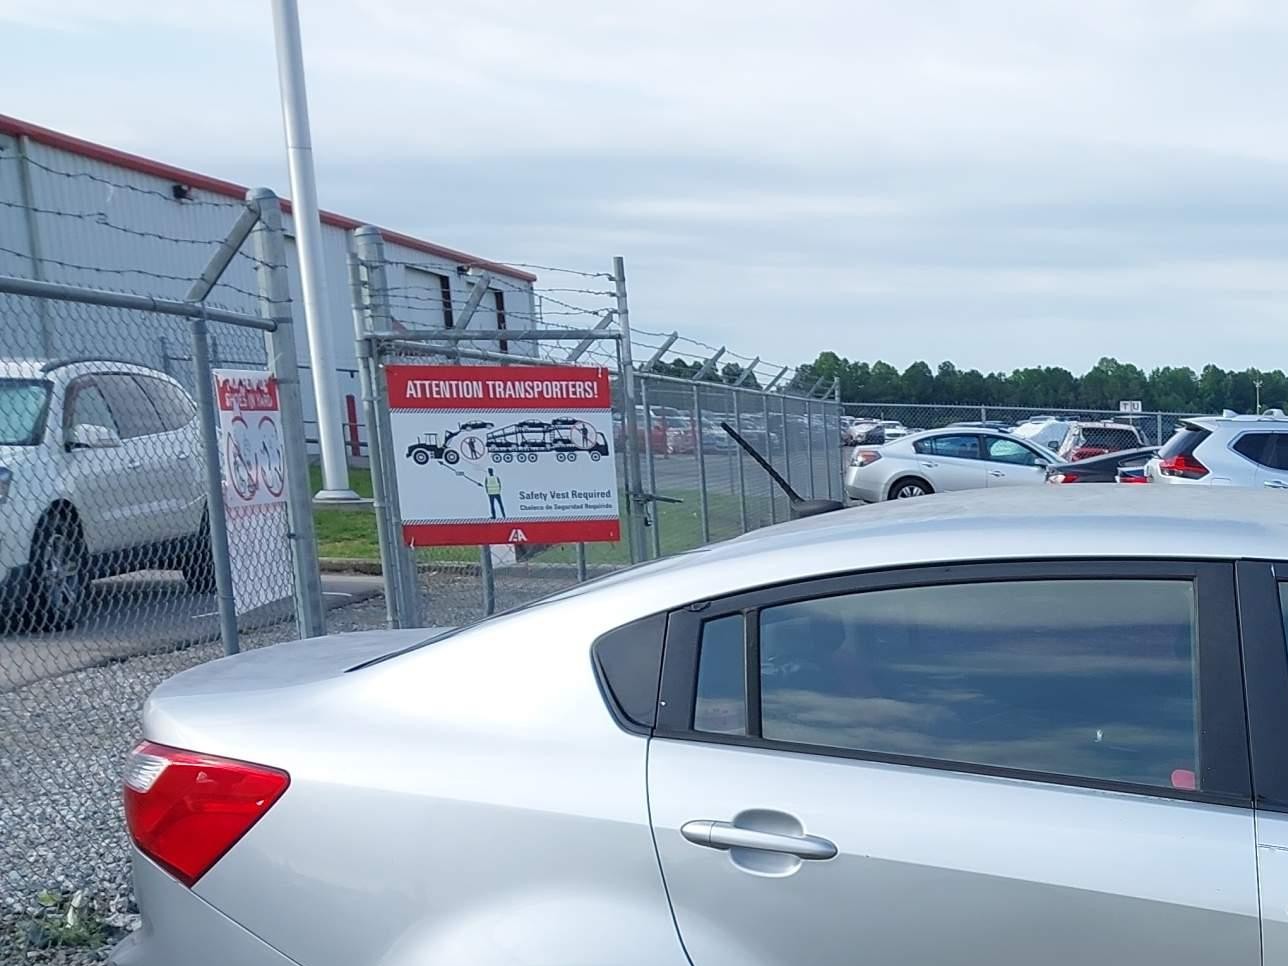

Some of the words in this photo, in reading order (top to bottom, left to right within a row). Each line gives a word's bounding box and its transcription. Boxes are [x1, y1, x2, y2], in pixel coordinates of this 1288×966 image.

[406, 380, 483, 398] ATTENTION
[486, 380, 598, 398] TRANSPORTERS!
[519, 490, 548, 502] Safety
[549, 490, 569, 499] Vest
[571, 489, 612, 501] Required
